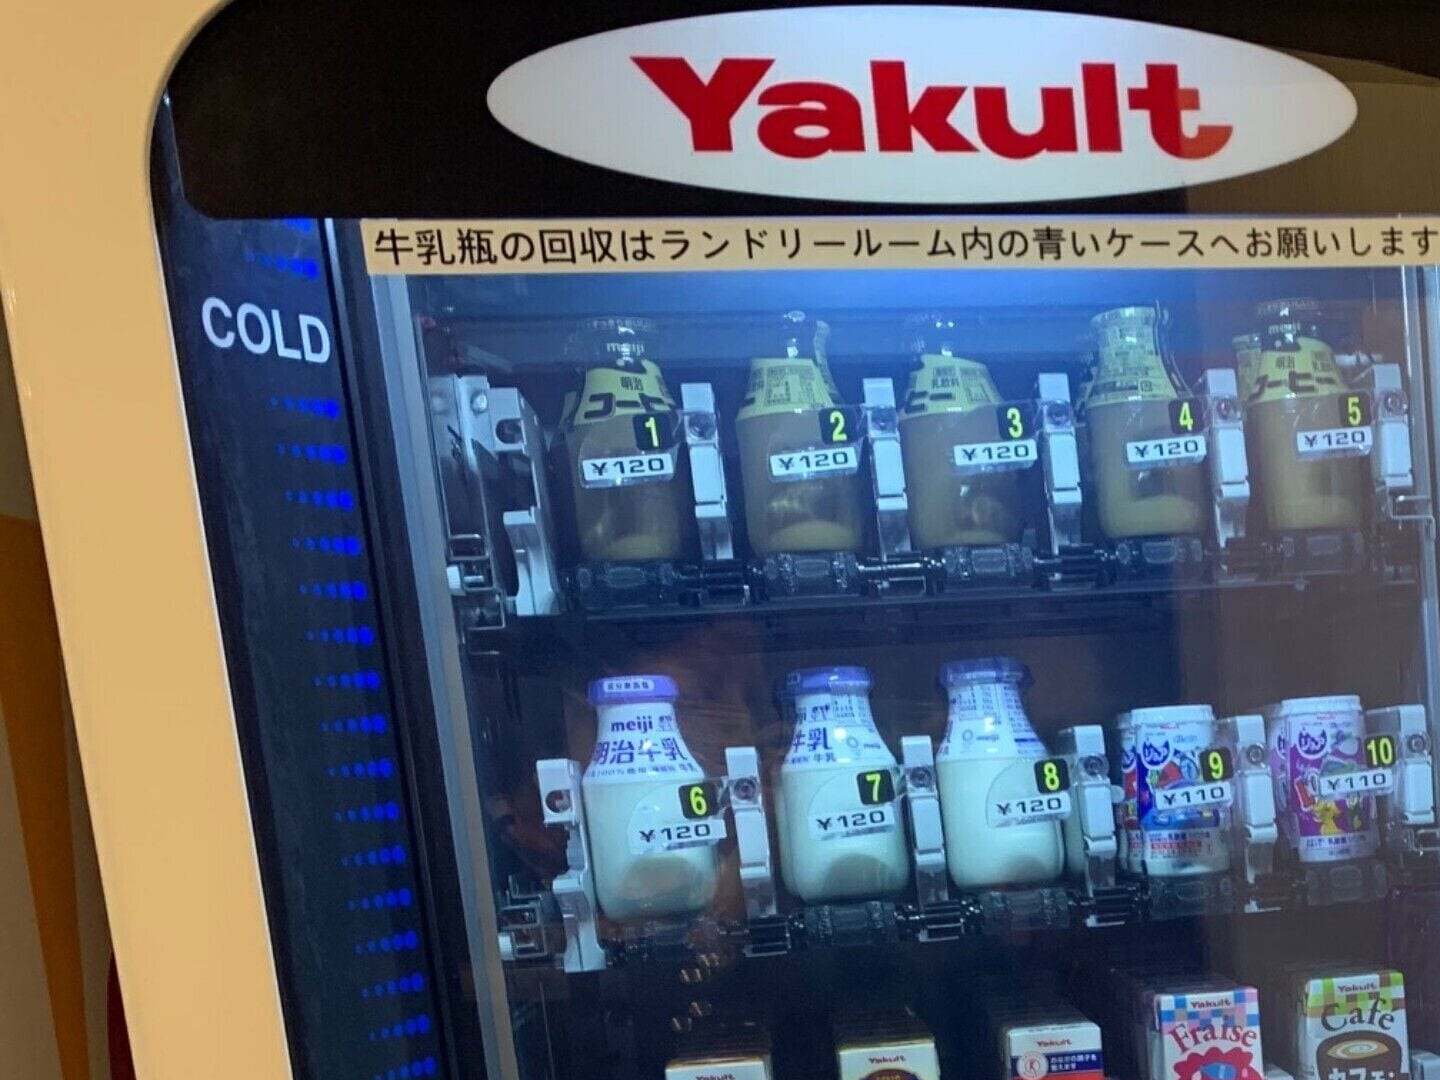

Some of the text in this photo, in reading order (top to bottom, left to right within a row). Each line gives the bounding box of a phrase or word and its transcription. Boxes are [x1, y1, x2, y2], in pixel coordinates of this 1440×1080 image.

[630, 56, 1233, 160] Yakult
[200, 296, 331, 364] COLD
[1006, 407, 1024, 438] 3
[1179, 401, 1194, 431] 4
[1347, 396, 1362, 426] 5
[645, 416, 660, 448] 1
[829, 411, 848, 442] 2
[1304, 430, 1366, 448] ¥120
[778, 451, 849, 472] ¥120
[962, 444, 1030, 462] ¥120
[1134, 439, 1199, 459] ¥120
[590, 457, 665, 477] ¥120
[611, 715, 654, 733] meiji
[1207, 751, 1224, 779] 9
[1366, 737, 1393, 765] 10
[865, 773, 882, 803] 7
[1043, 762, 1060, 791] 8
[1327, 773, 1387, 792] ¥110
[689, 787, 708, 816] 6
[996, 797, 1062, 816] ¥120
[1162, 786, 1225, 805] ¥110
[639, 823, 712, 843] ¥120
[816, 809, 887, 831] ¥120
[1168, 1015, 1258, 1054] Fraise
